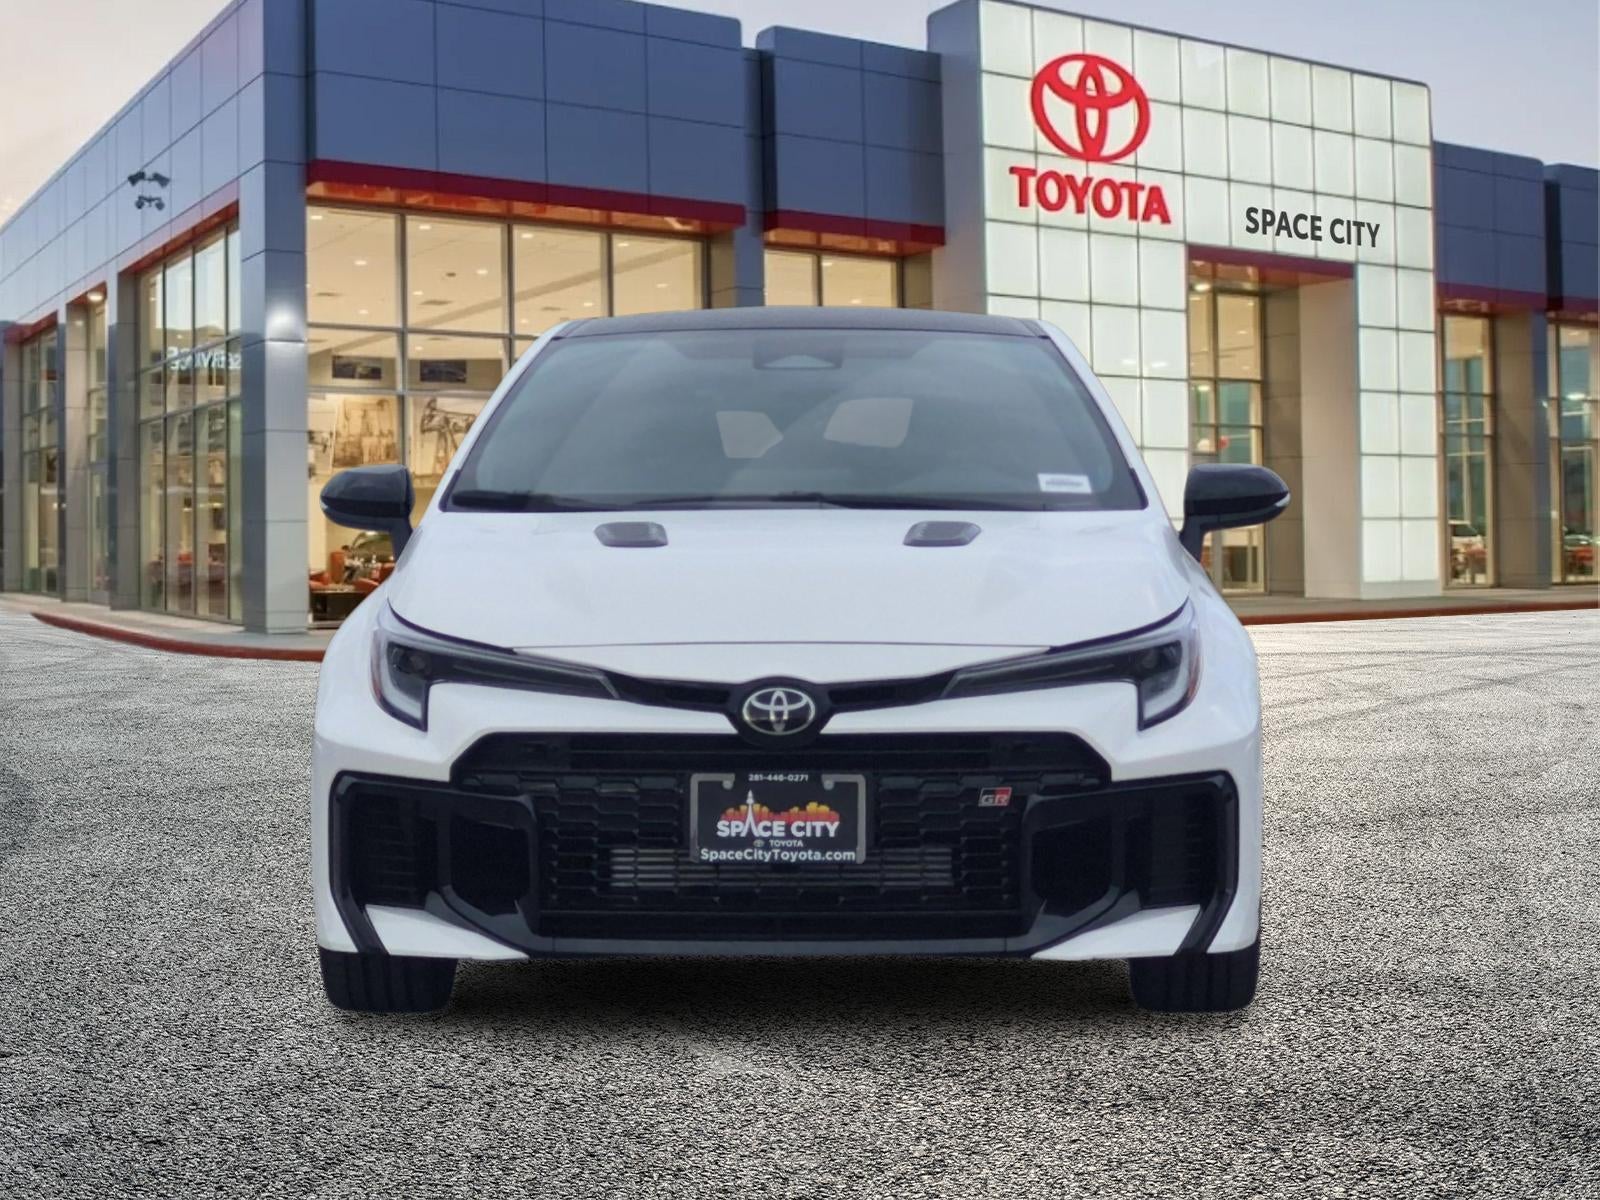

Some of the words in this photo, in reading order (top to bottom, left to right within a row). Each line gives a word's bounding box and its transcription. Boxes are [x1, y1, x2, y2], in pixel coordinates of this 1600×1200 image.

[1009, 166, 1171, 225] TOYOTA
[1245, 207, 1322, 241] SPACE
[1329, 219, 1380, 248] CITY
[981, 794, 1010, 807] GR
[716, 803, 785, 838] SPACE
[790, 821, 840, 838] CITY
[700, 848, 856, 862] SpaceCityToyota.com
[769, 839, 804, 848] TOYOTA
